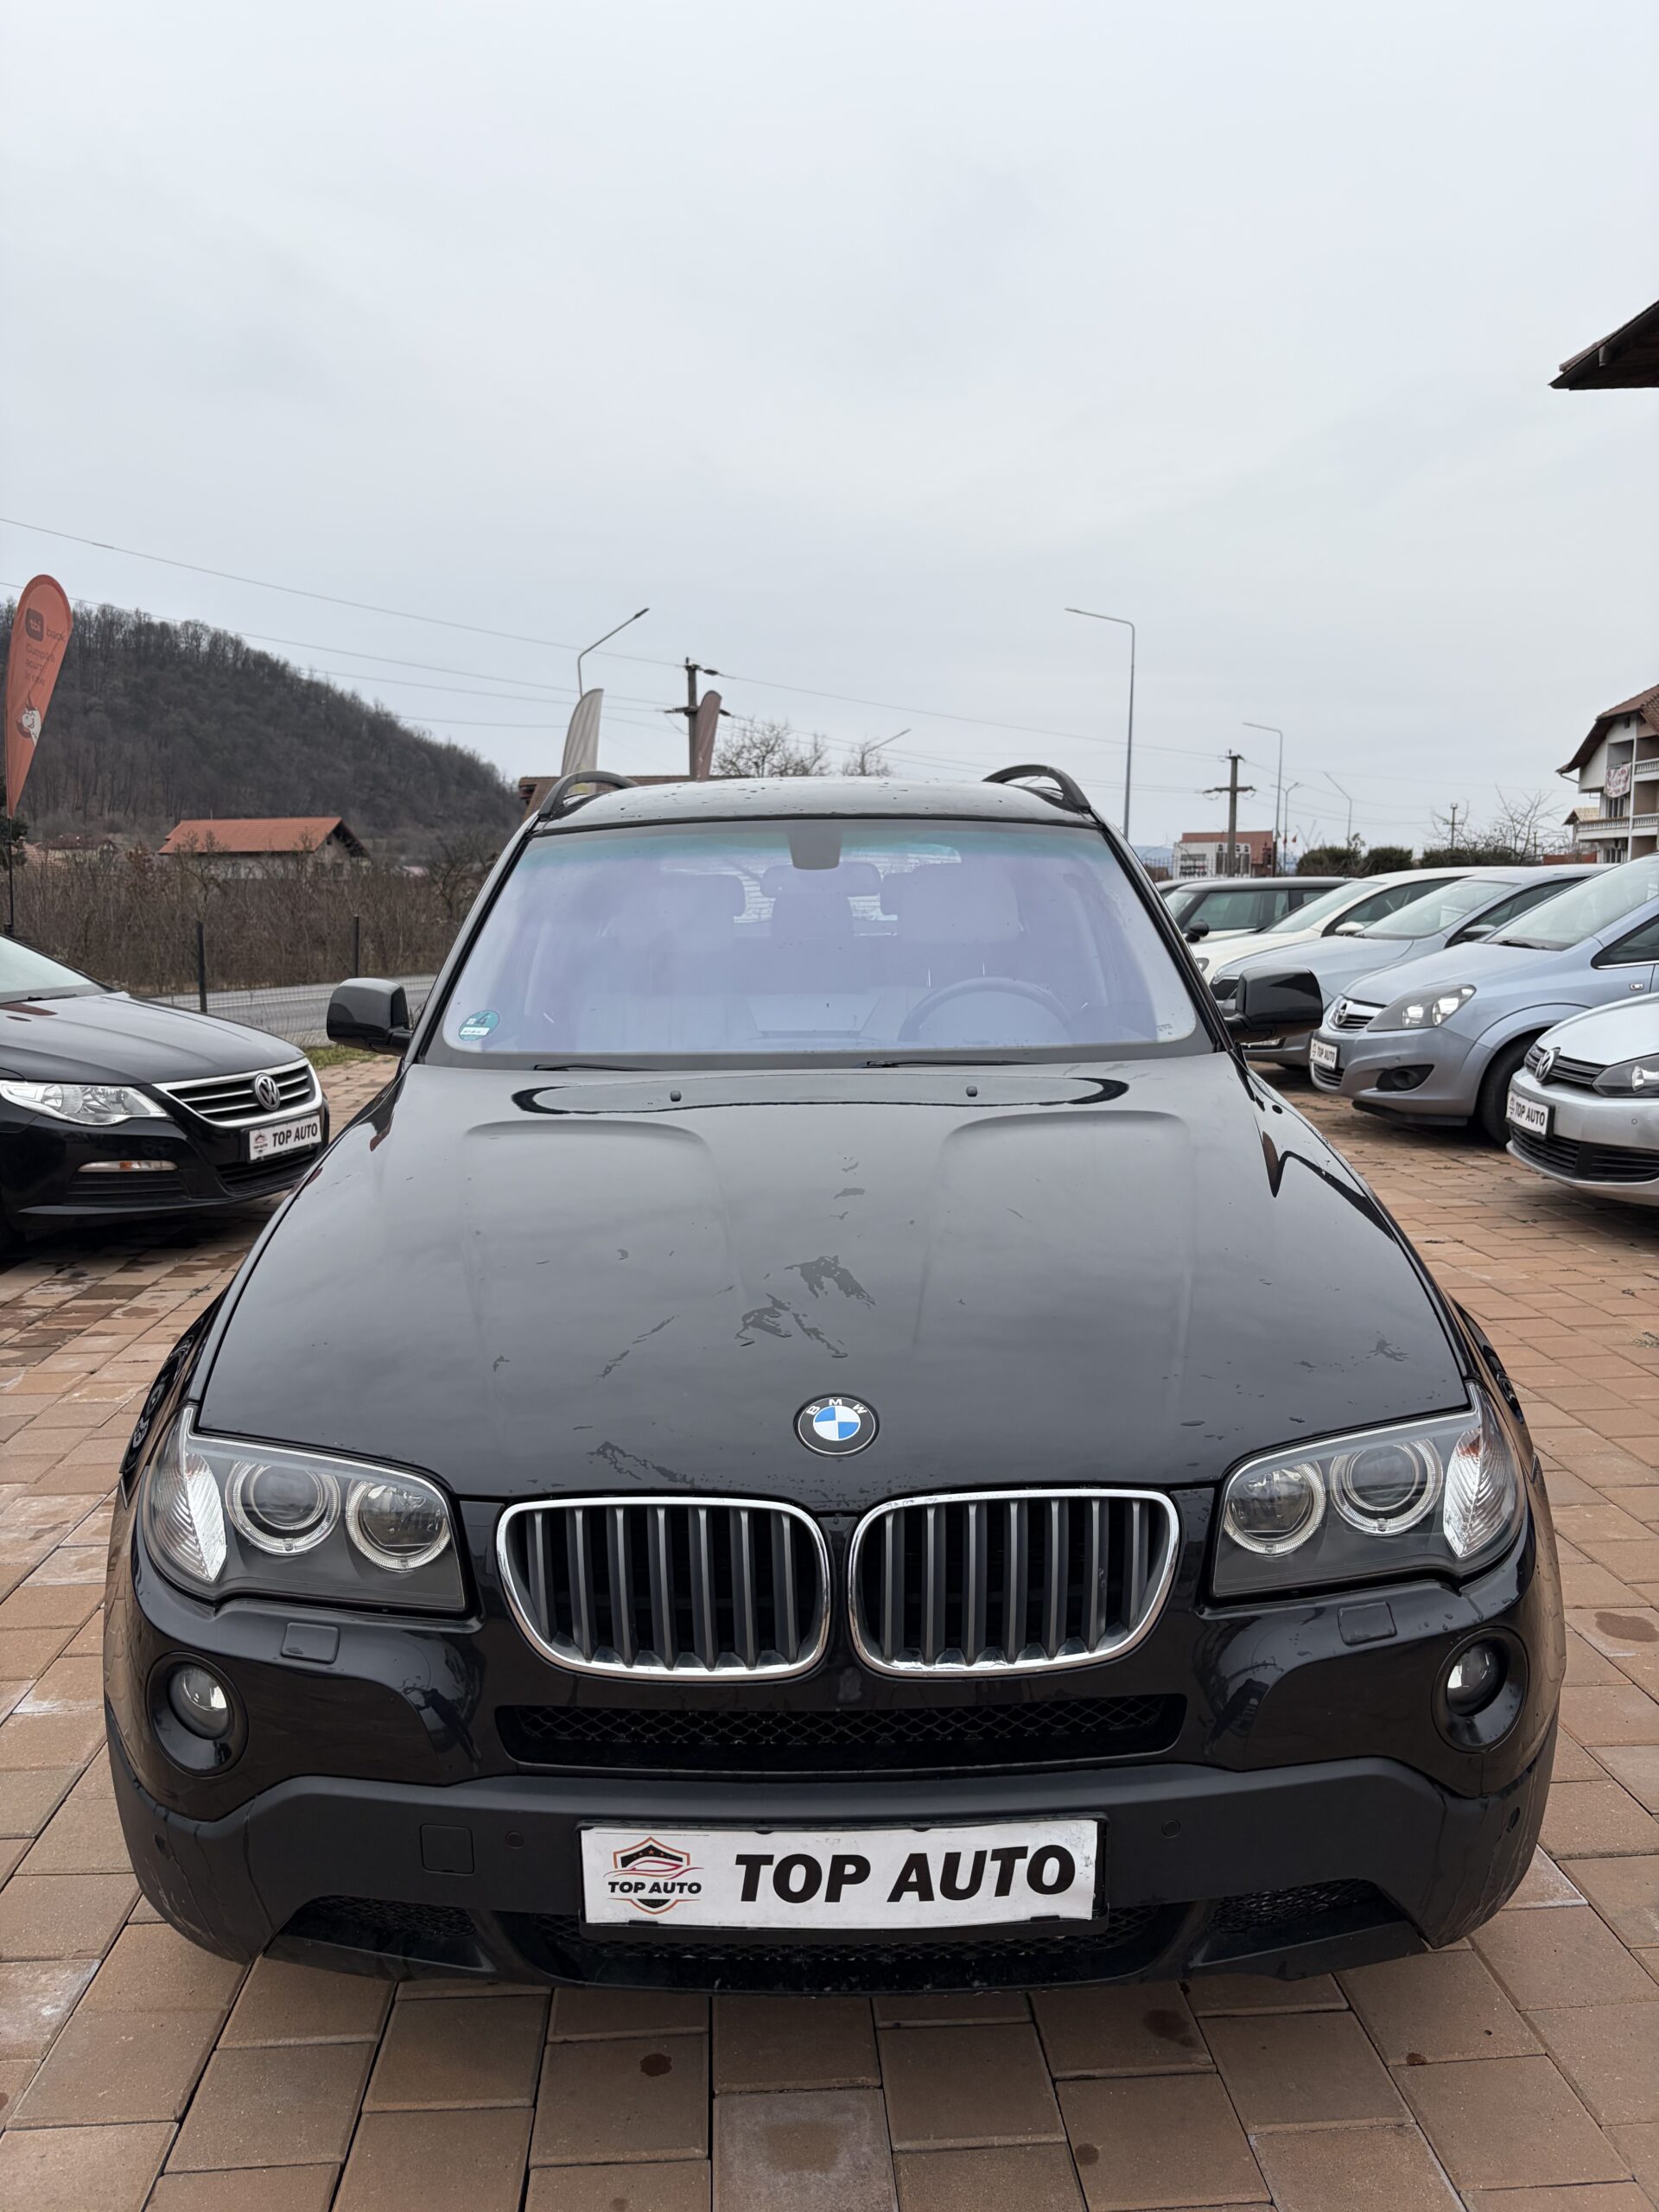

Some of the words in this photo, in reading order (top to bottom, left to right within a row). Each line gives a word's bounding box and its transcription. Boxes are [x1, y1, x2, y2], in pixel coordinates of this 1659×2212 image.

[1515, 1102, 1526, 1119] TOP
[1525, 1107, 1545, 1127] AUTO
[272, 1129, 292, 1147] TOP
[294, 1122, 318, 1142] AUTO
[806, 1398, 868, 1415] BMW
[734, 1853, 871, 1904] TOP
[887, 1845, 1076, 1903] AUTO
[607, 1881, 646, 1893] TOP
[648, 1882, 702, 1894] AUTO
